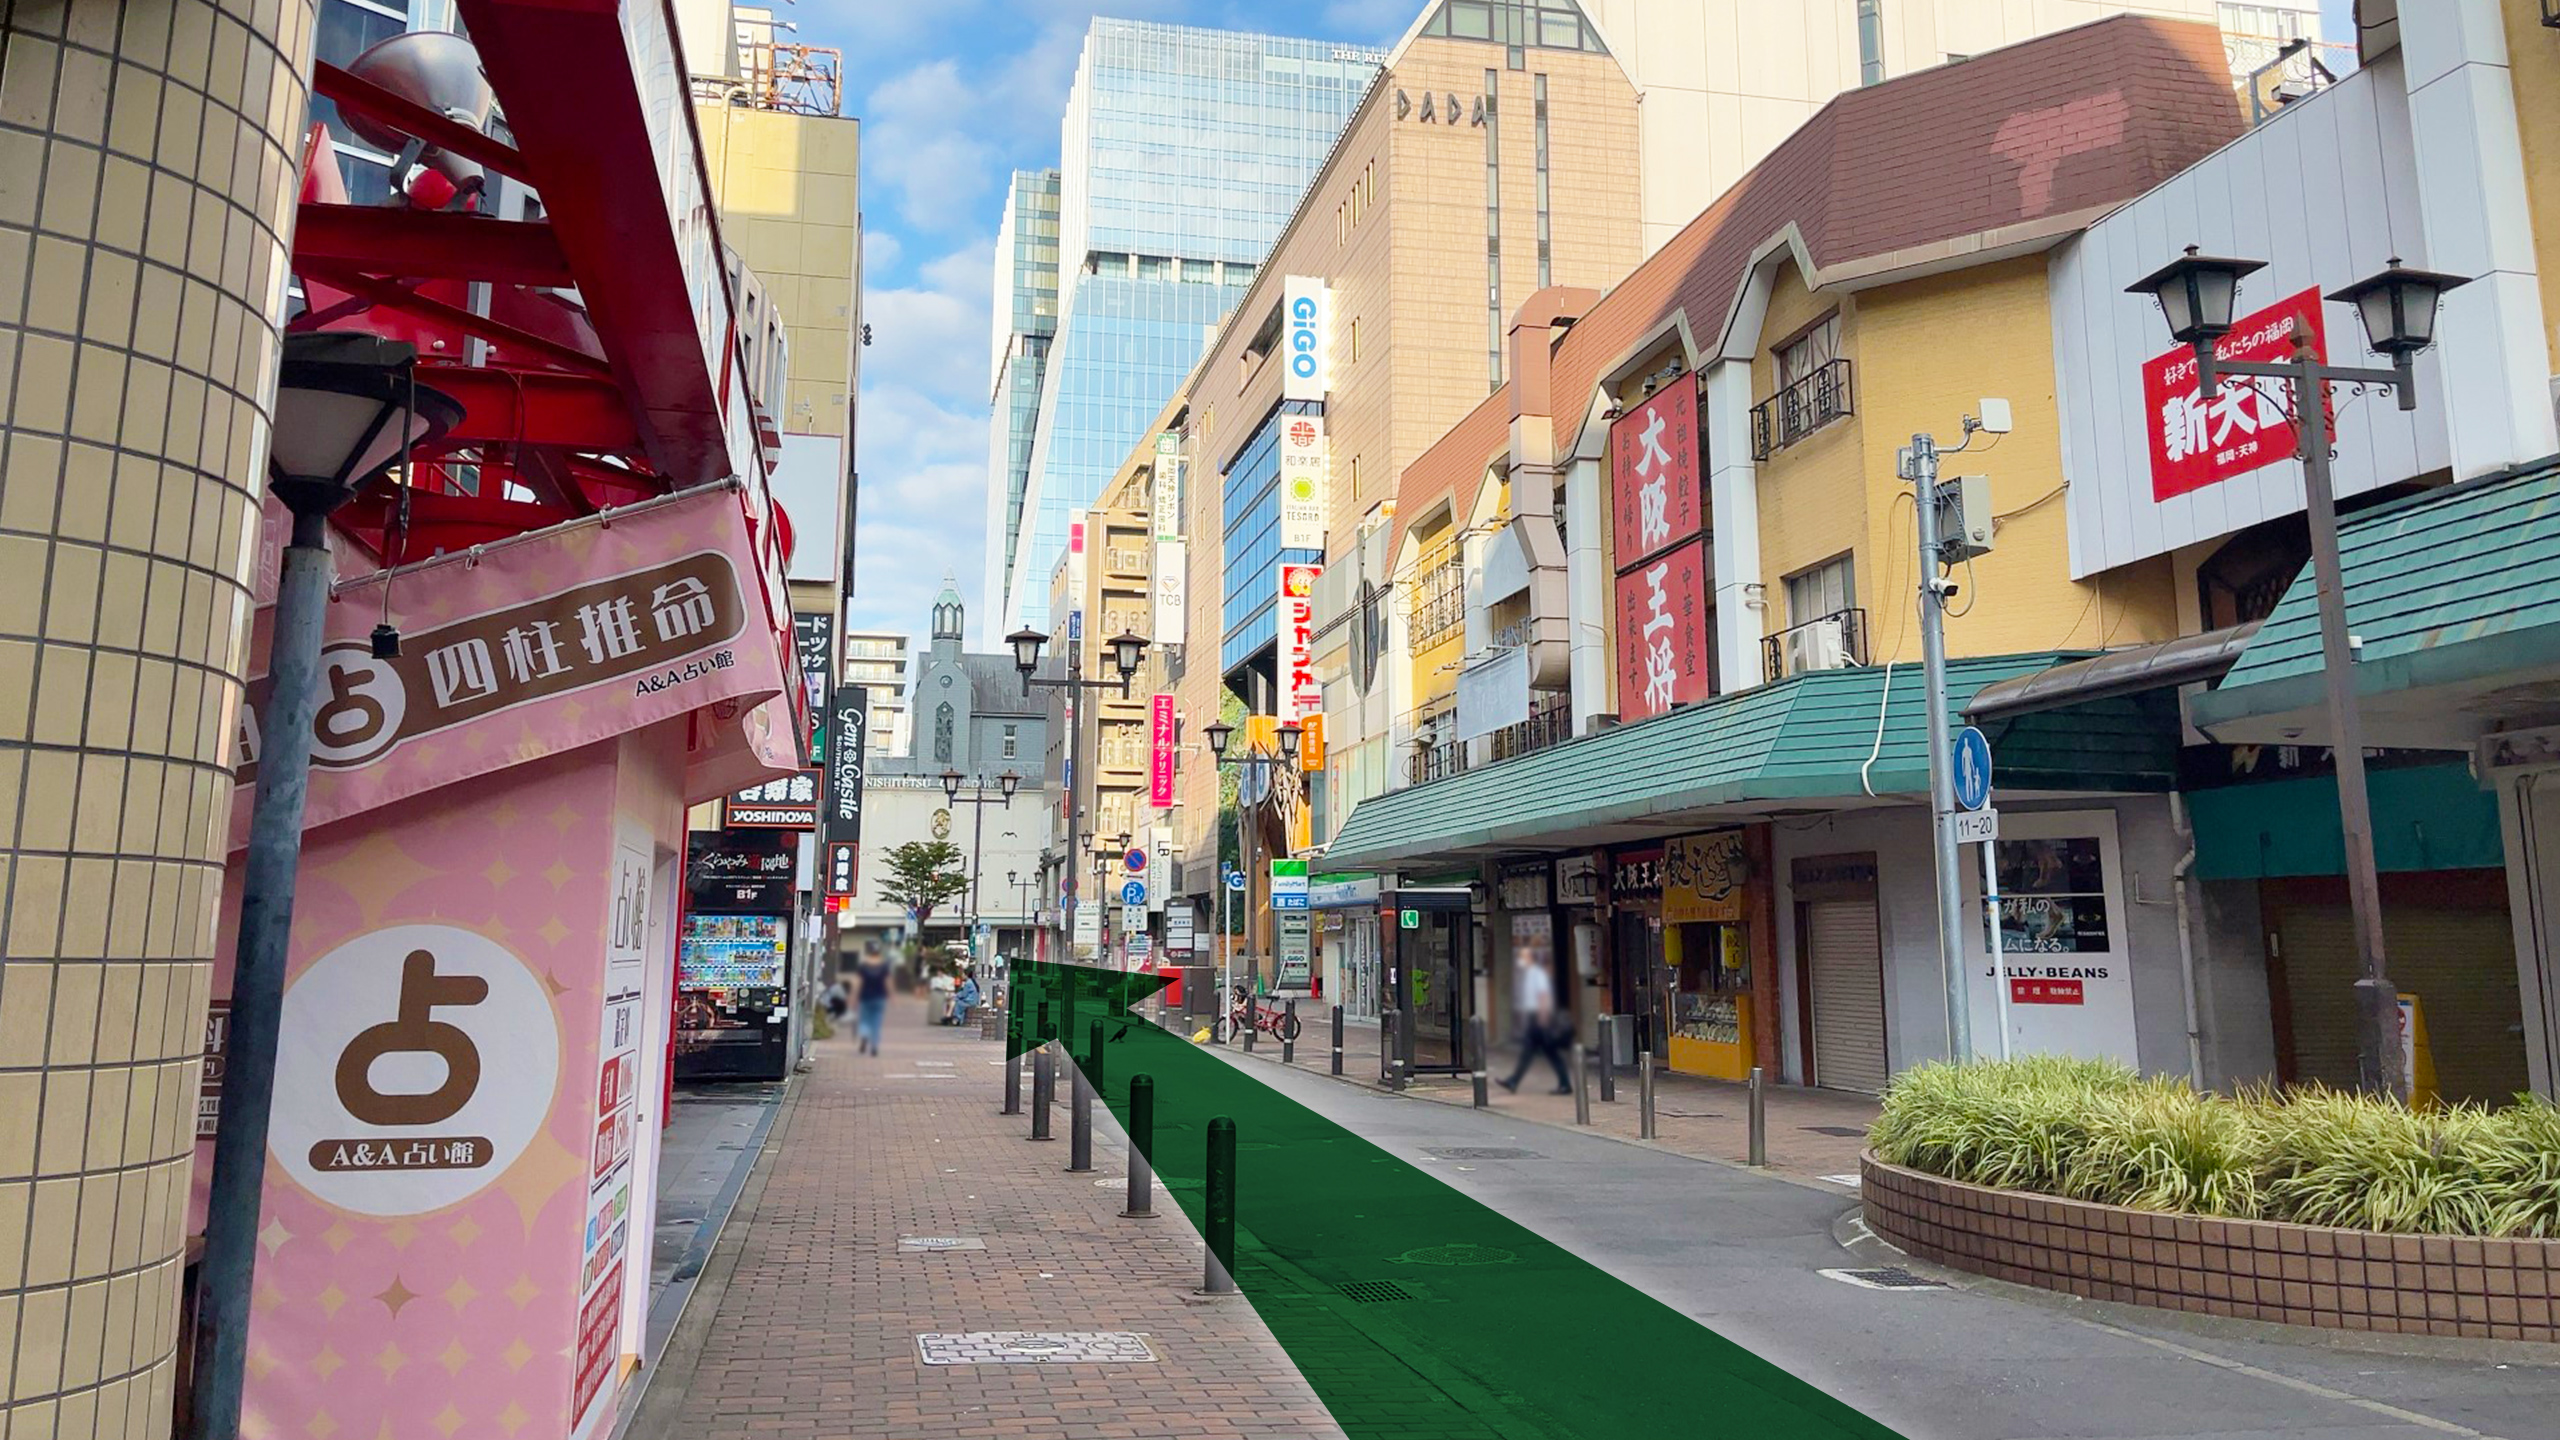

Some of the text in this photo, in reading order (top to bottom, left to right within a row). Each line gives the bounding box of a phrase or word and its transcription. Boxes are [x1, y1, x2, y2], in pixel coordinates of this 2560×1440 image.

[1331, 49, 1360, 61] THE
[1396, 88, 1487, 128] DADA
[1292, 296, 1317, 379] GiGO
[1294, 534, 1312, 543] B1F
[1159, 593, 1182, 606] TCB
[424, 575, 717, 709] 四柱推命
[837, 707, 864, 821] Gem Castle
[864, 776, 932, 789] NISHITETSU
[733, 809, 814, 825] YOSHINOYA
[1957, 815, 1993, 837] 11-20
[736, 888, 759, 900] B1F
[335, 949, 489, 1127] 占
